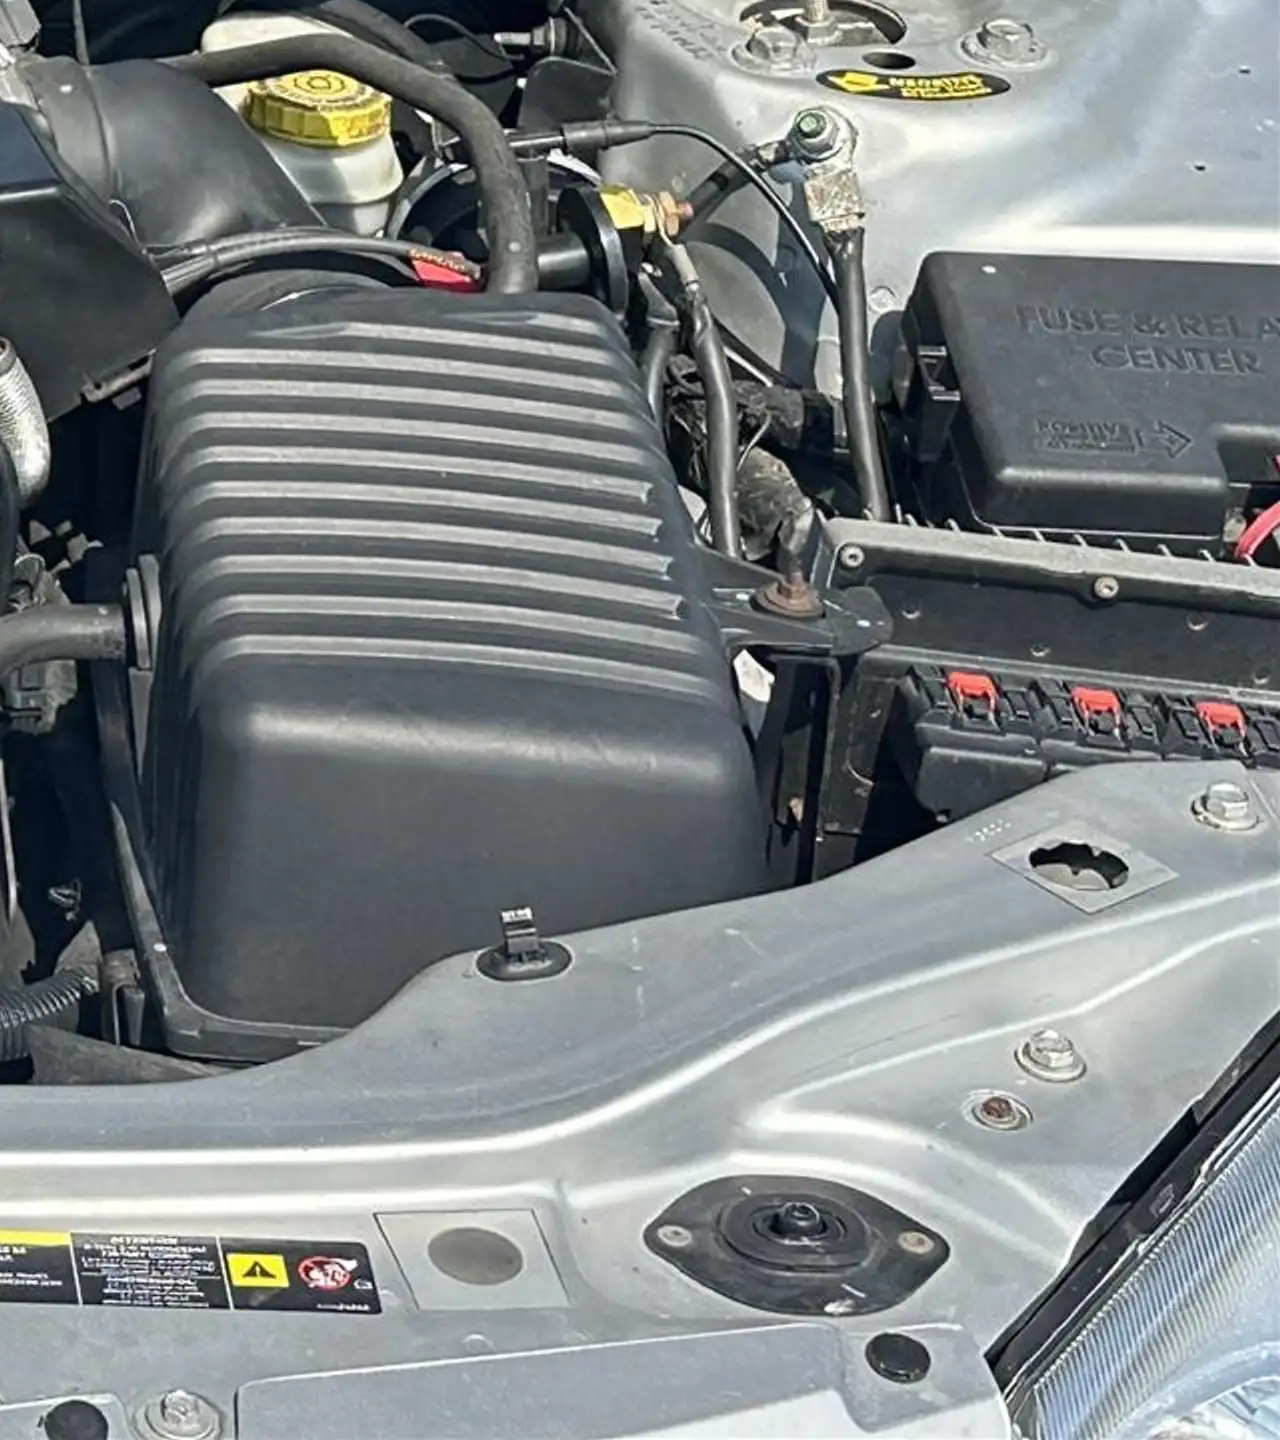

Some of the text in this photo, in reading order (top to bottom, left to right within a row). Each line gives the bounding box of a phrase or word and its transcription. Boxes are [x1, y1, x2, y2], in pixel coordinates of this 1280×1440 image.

[1016, 304, 1280, 341] FUSE & RELA
[1090, 343, 1263, 376] CENTER
